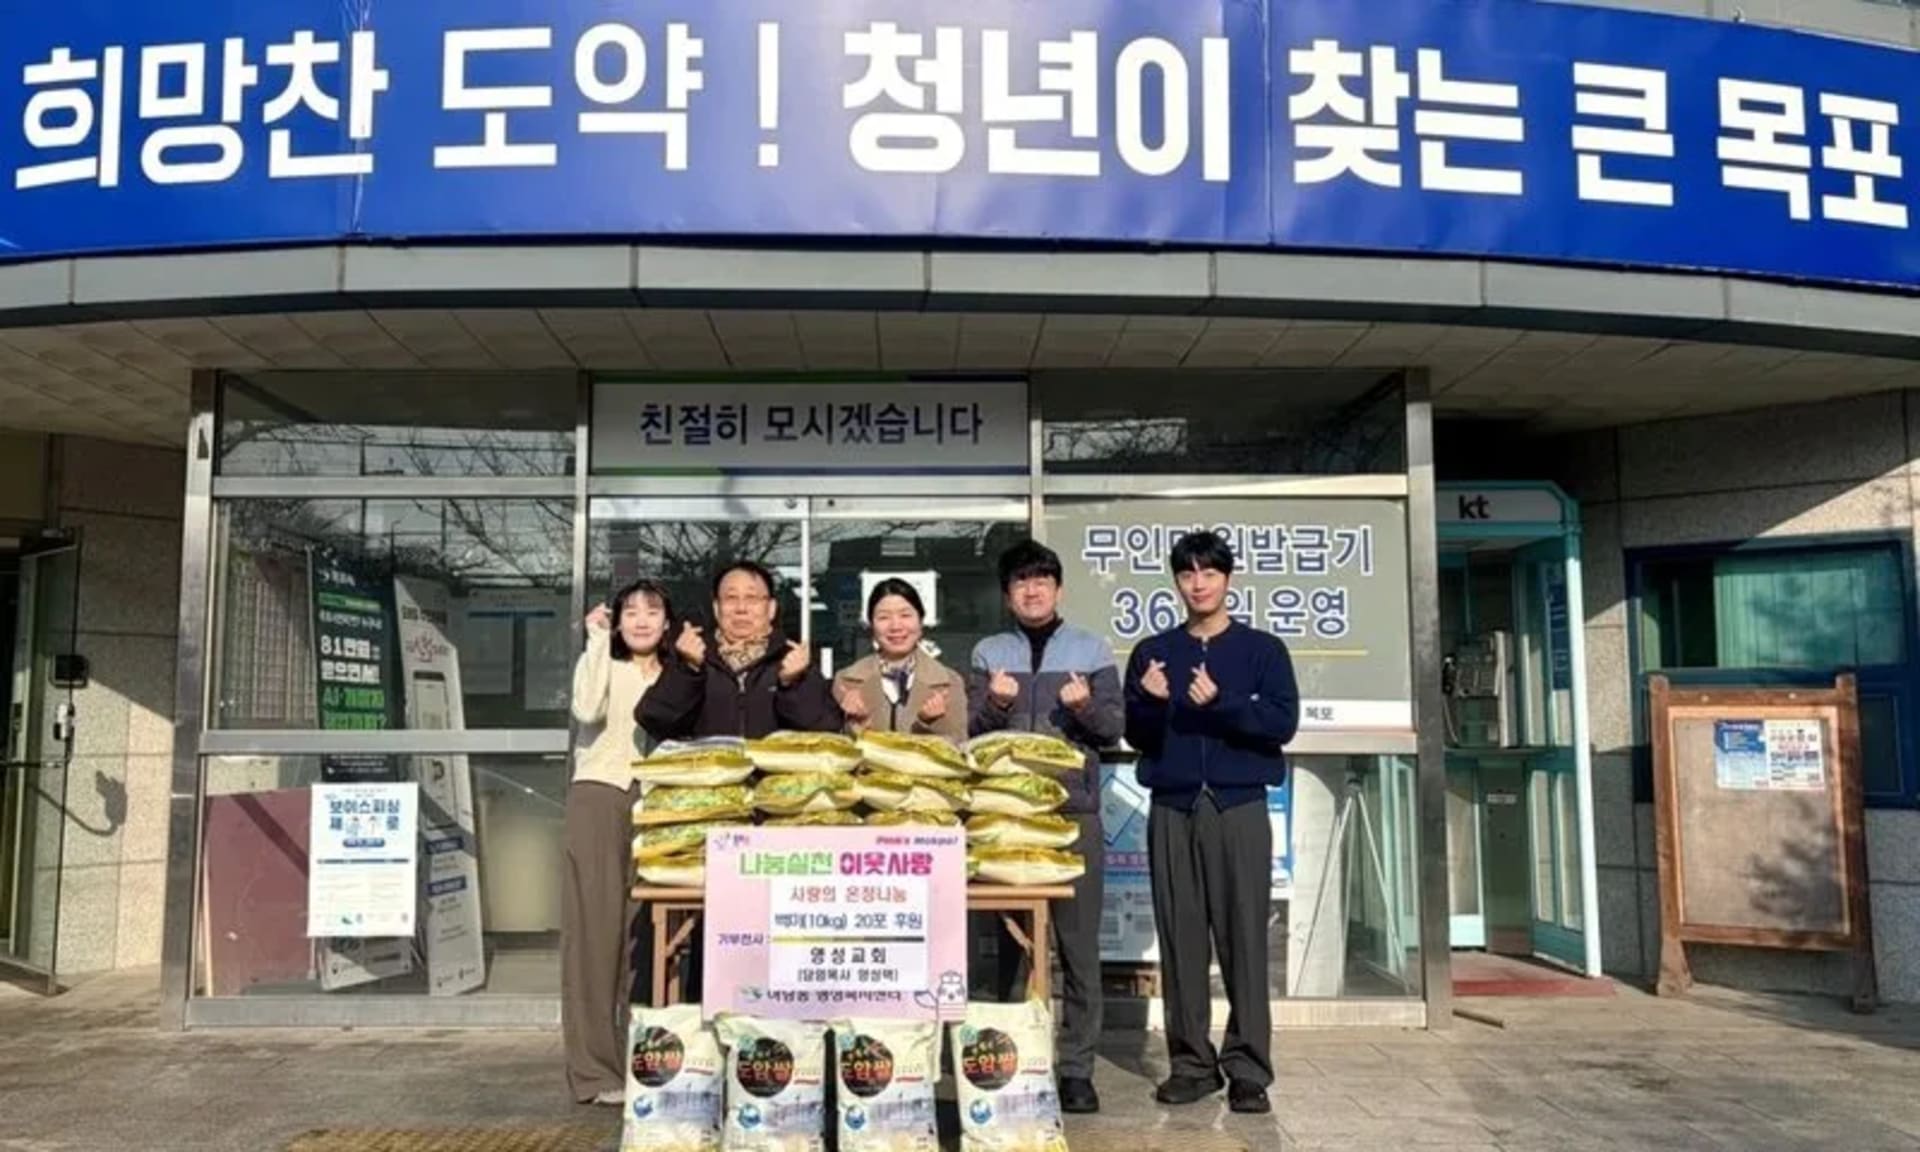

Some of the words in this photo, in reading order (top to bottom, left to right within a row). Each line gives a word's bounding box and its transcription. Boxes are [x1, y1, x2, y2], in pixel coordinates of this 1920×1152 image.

[15, 30, 389, 190] 희망찬
[433, 22, 704, 171] 도약
[757, 22, 780, 167] !
[844, 22, 1230, 182] 청년이
[1288, 40, 1524, 195] 찾는
[1571, 61, 1674, 206] 큰
[1717, 77, 1909, 229] 목포
[640, 403, 748, 446] 친절히
[763, 402, 984, 445] 모시겠습니다
[1459, 495, 1490, 519] kt
[1113, 589, 1256, 636] 36일
[1266, 588, 1348, 636] 운영
[329, 799, 399, 813] 보이스피싱
[740, 852, 833, 875] 나눔실천
[840, 851, 933, 876] 이웃사랑
[790, 885, 836, 902] 사랑의
[846, 885, 907, 902] 온정나눔
[774, 911, 847, 930] 백미(10kg)
[854, 912, 888, 930] 20포
[895, 911, 923, 930] 후원
